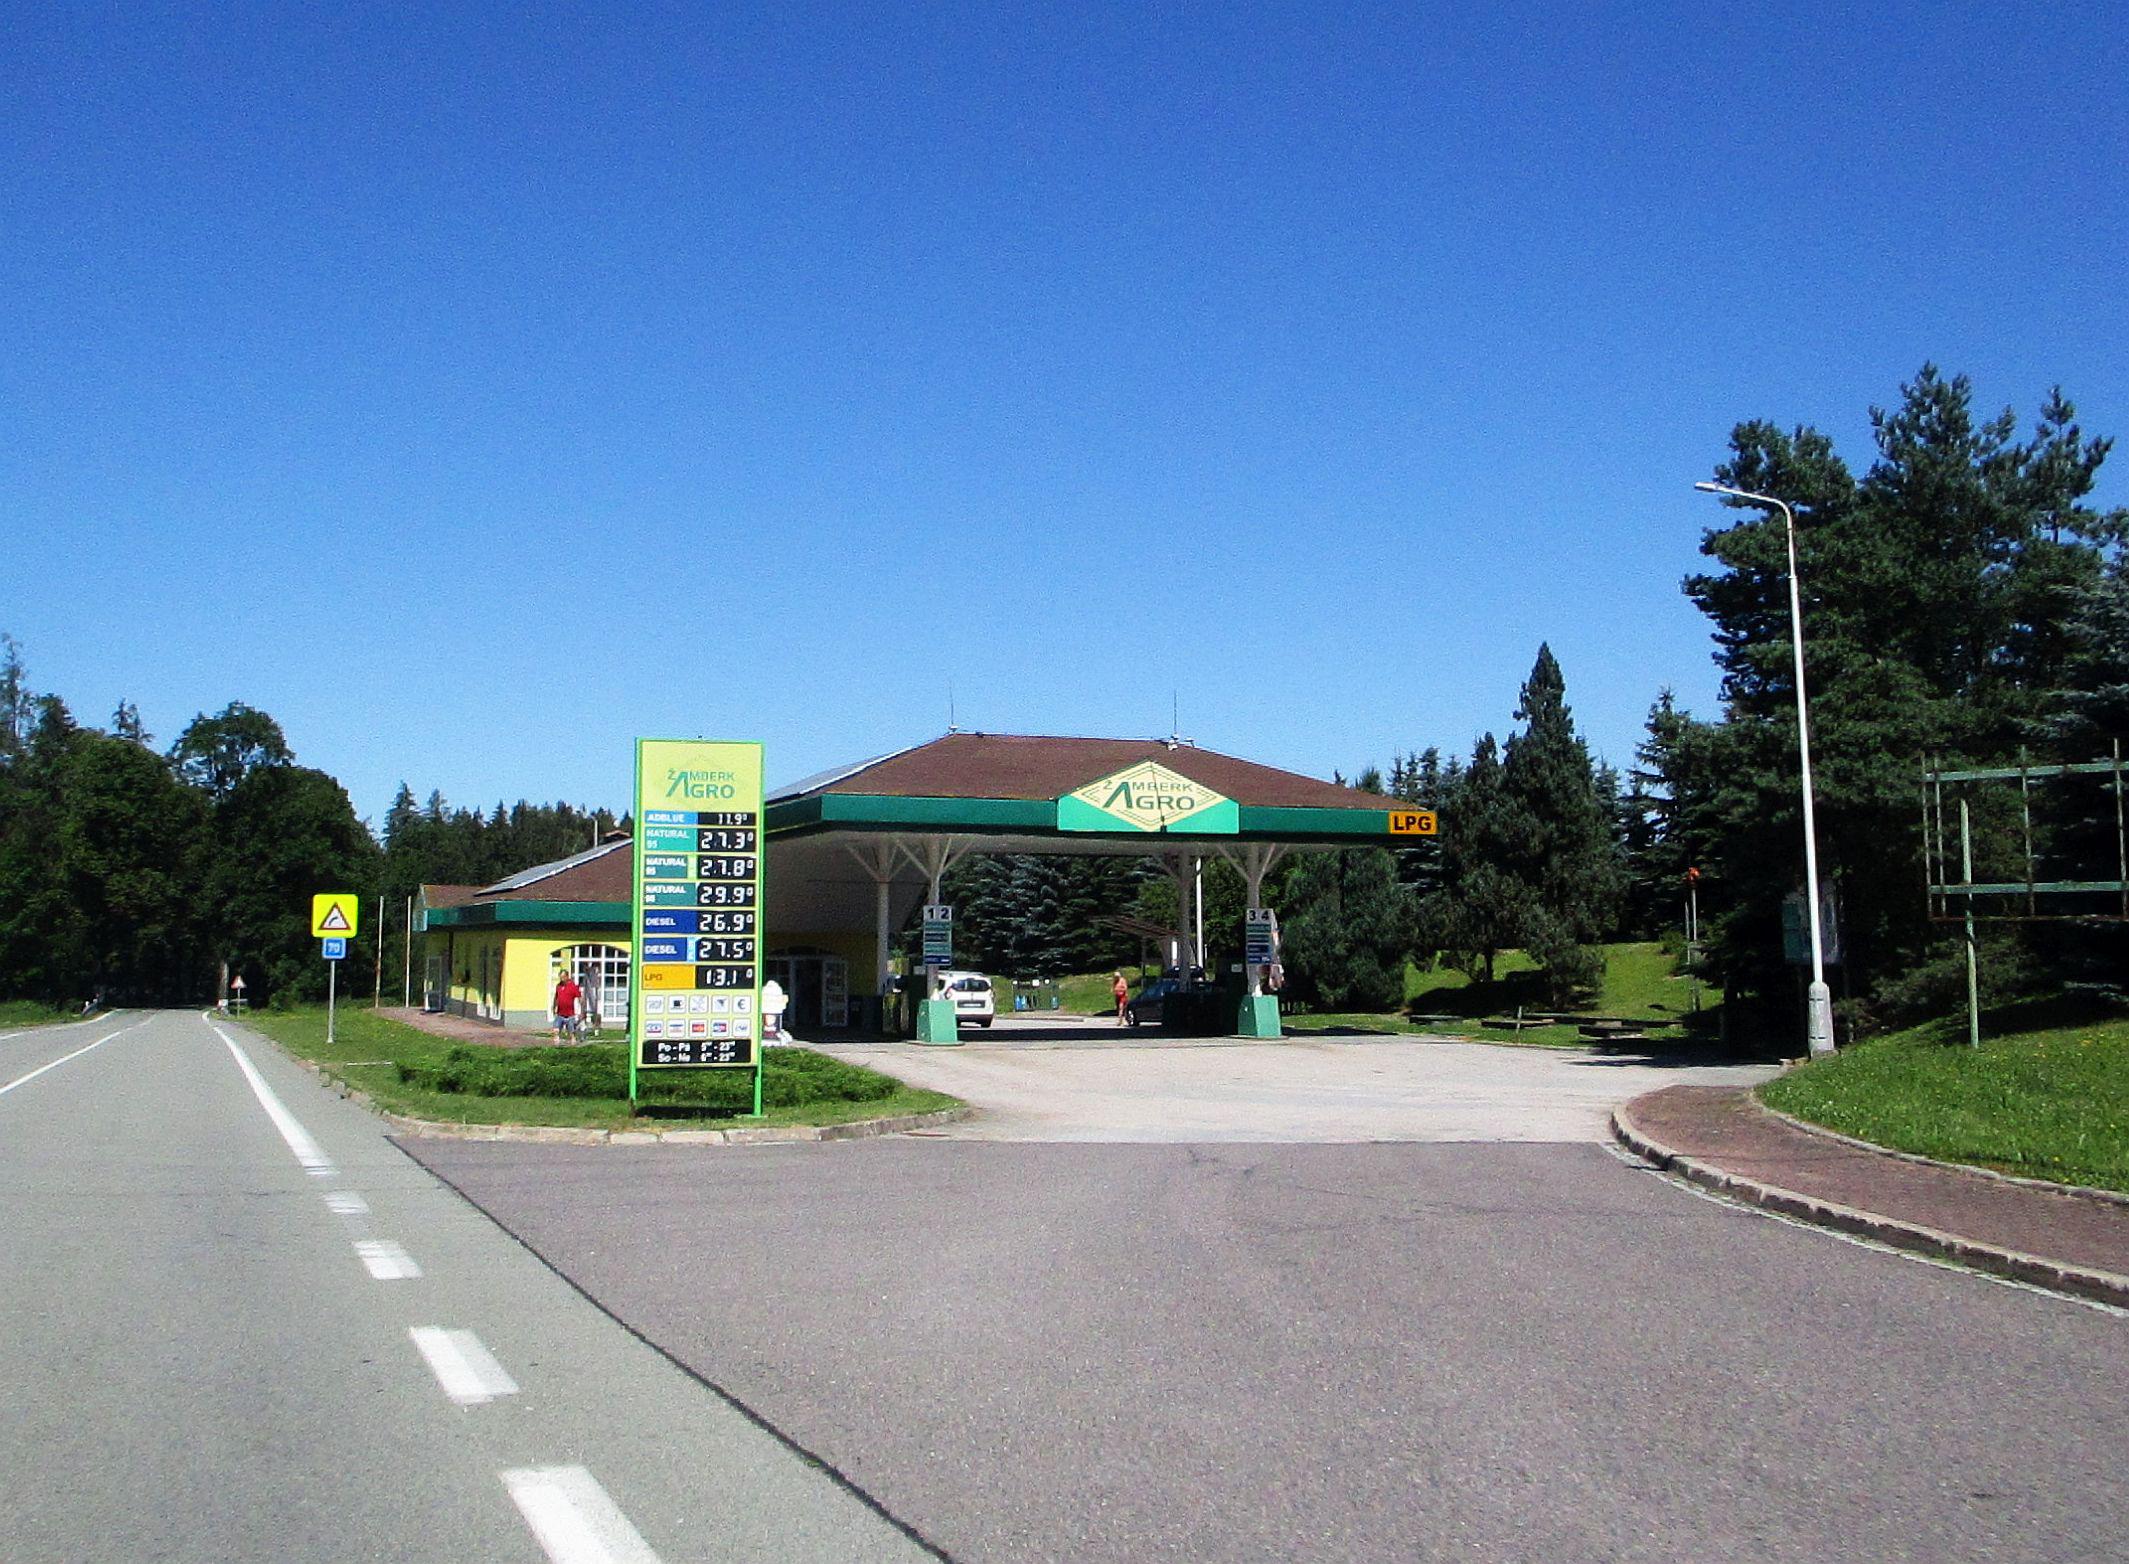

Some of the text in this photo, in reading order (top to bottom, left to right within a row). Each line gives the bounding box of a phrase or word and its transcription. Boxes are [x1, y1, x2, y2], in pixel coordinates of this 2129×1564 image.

[1102, 781, 1195, 810] AGRO
[647, 813, 684, 823] ADBLUE
[1394, 815, 1431, 831] LPG
[646, 829, 689, 838] NATURAL
[646, 857, 687, 867] NATURAL
[645, 884, 686, 894] NATURAL
[928, 908, 949, 919] 1 2
[1249, 910, 1269, 921] 3 4
[645, 917, 676, 926] DIESEL
[644, 944, 678, 955] DIESEL
